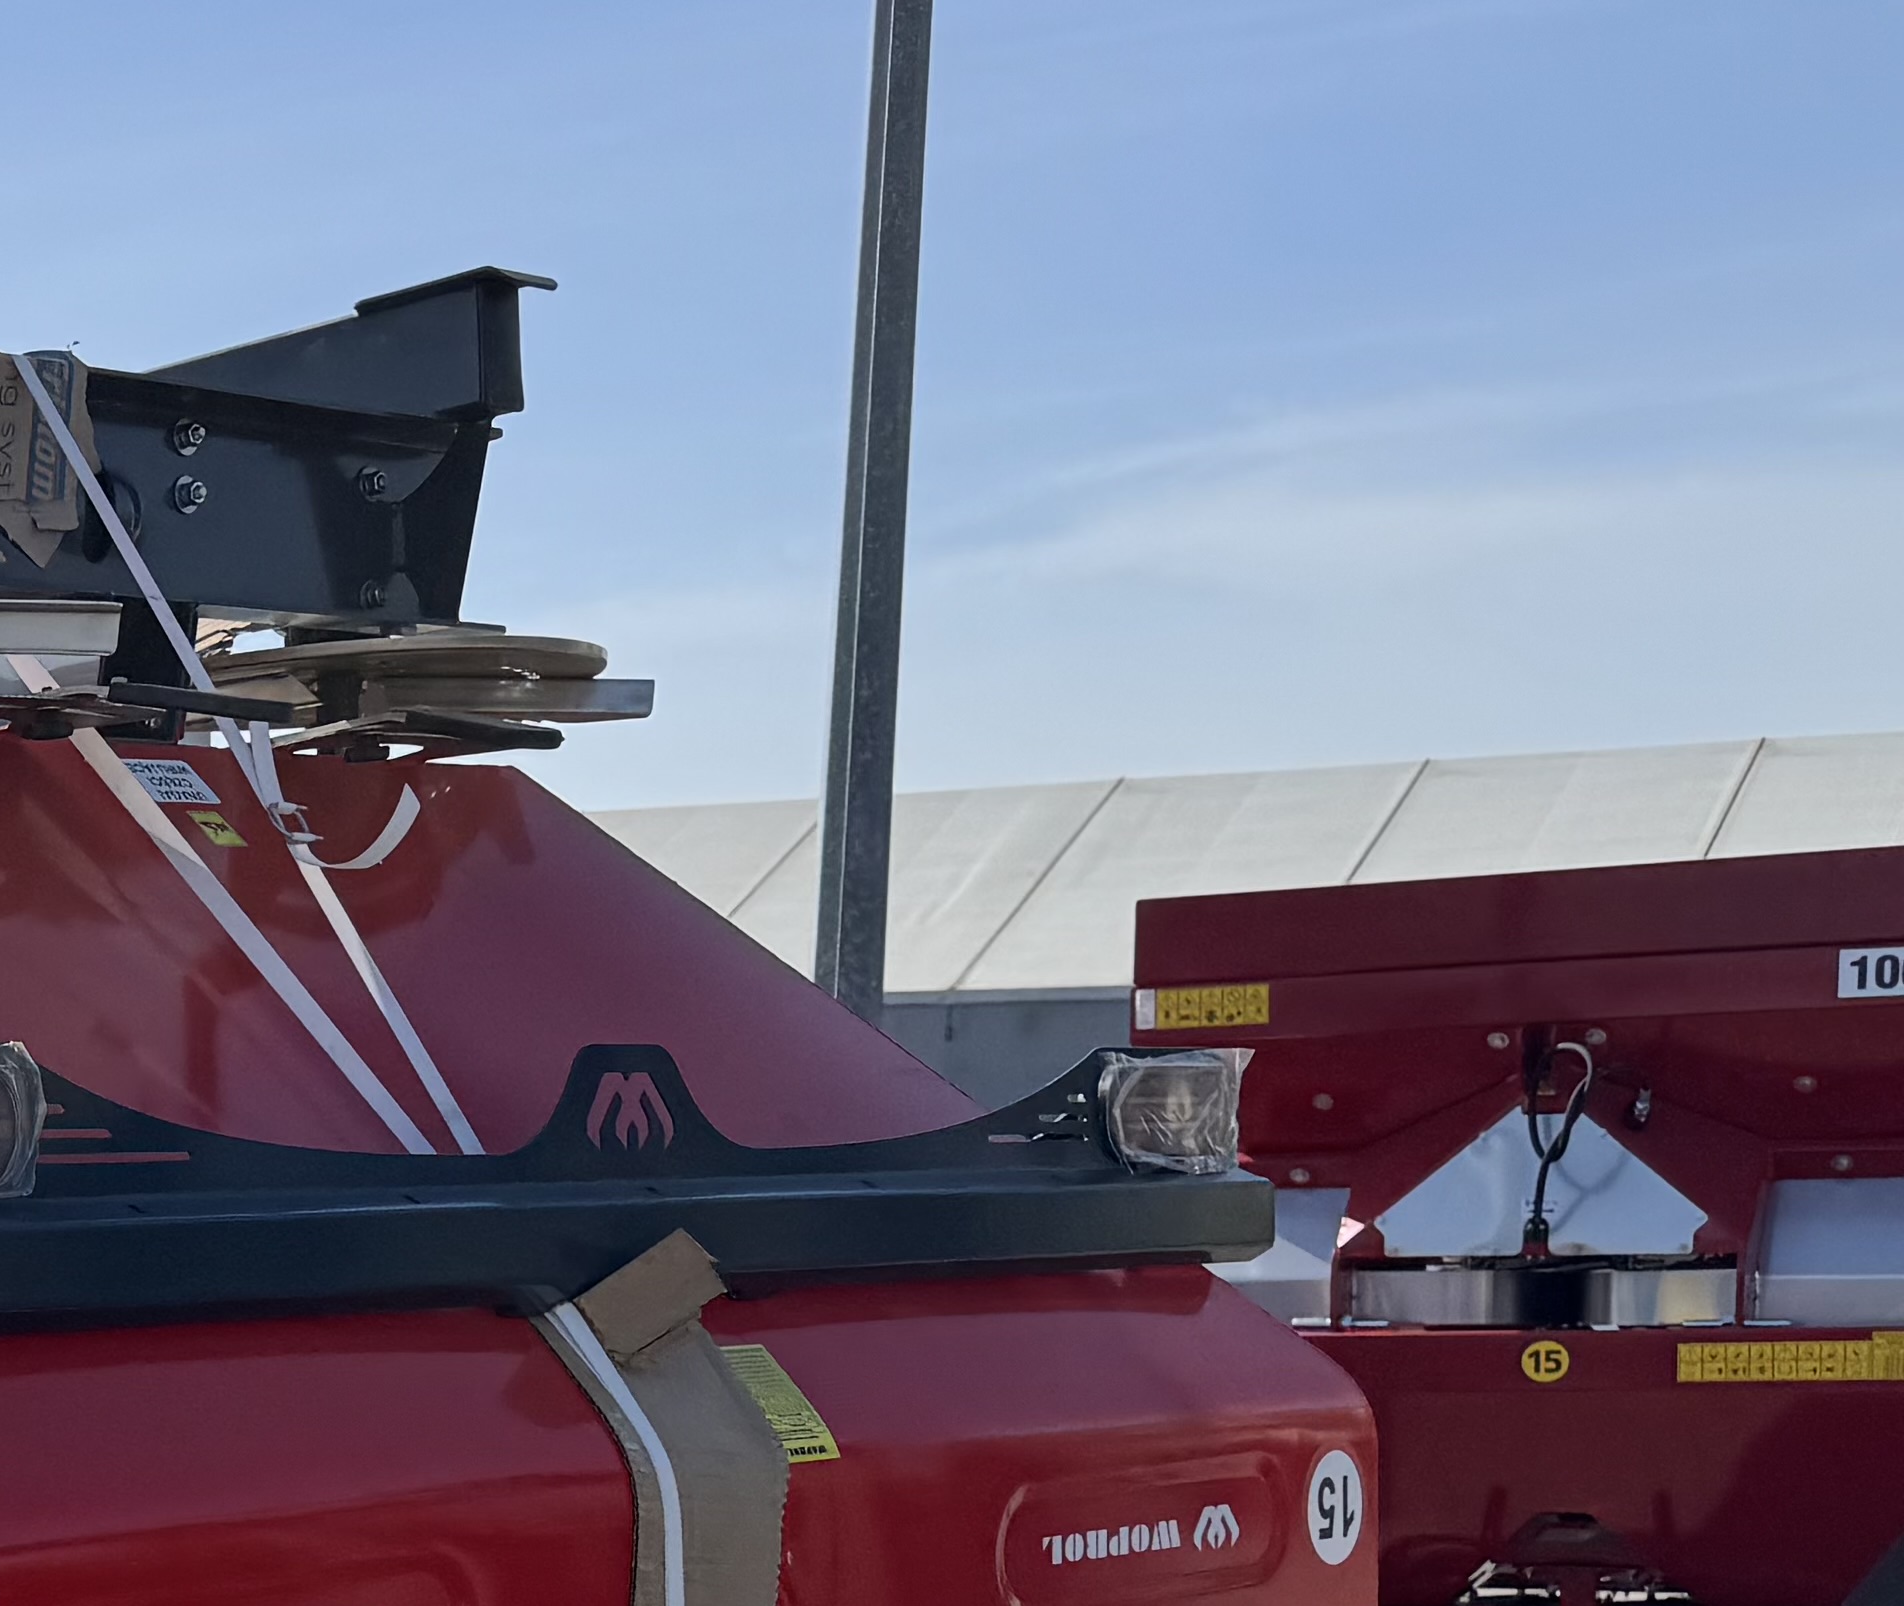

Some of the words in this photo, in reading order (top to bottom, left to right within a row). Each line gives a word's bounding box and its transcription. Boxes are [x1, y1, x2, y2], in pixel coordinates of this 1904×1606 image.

[1850, 954, 1904, 990] 10
[1527, 1349, 1562, 1374] 15
[1317, 1473, 1357, 1541] 15
[1042, 1520, 1181, 1565] WOPROL
